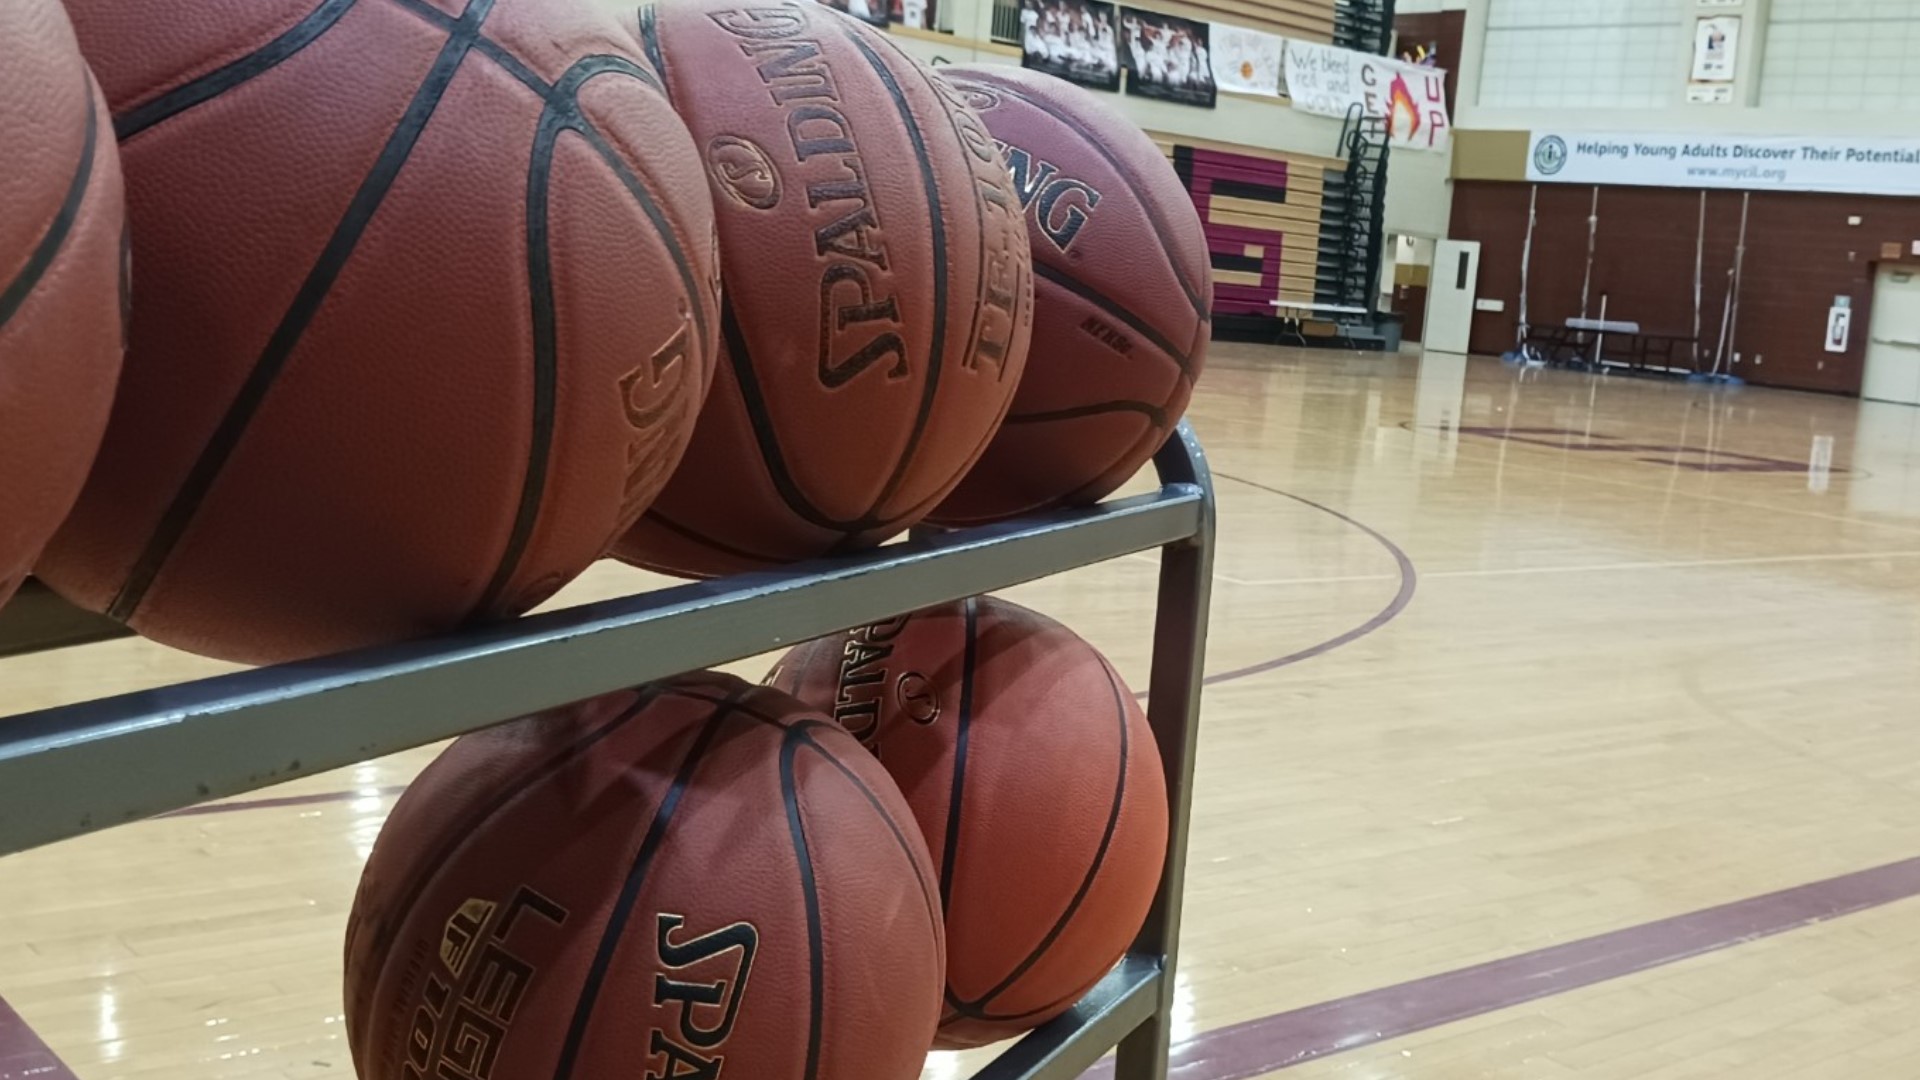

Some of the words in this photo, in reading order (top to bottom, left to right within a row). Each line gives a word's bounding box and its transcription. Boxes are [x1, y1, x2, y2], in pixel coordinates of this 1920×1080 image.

[1291, 47, 1317, 71] We
[1320, 48, 1350, 75] bleed
[1295, 72, 1318, 89] red
[1326, 76, 1351, 95] and
[1425, 75, 1446, 147] UP
[1577, 142, 1629, 160] Helping
[1633, 143, 1677, 161] Young
[1681, 144, 1728, 159] Adults
[1733, 145, 1795, 161] Discover
[1801, 146, 1840, 162] Their
[1846, 148, 1920, 164] Potential
[1686, 166, 1787, 183] www.mycil.org
[706, 7, 909, 389] SPALDING
[437, 885, 570, 1080] LEG
[644, 912, 759, 1080] SPA
